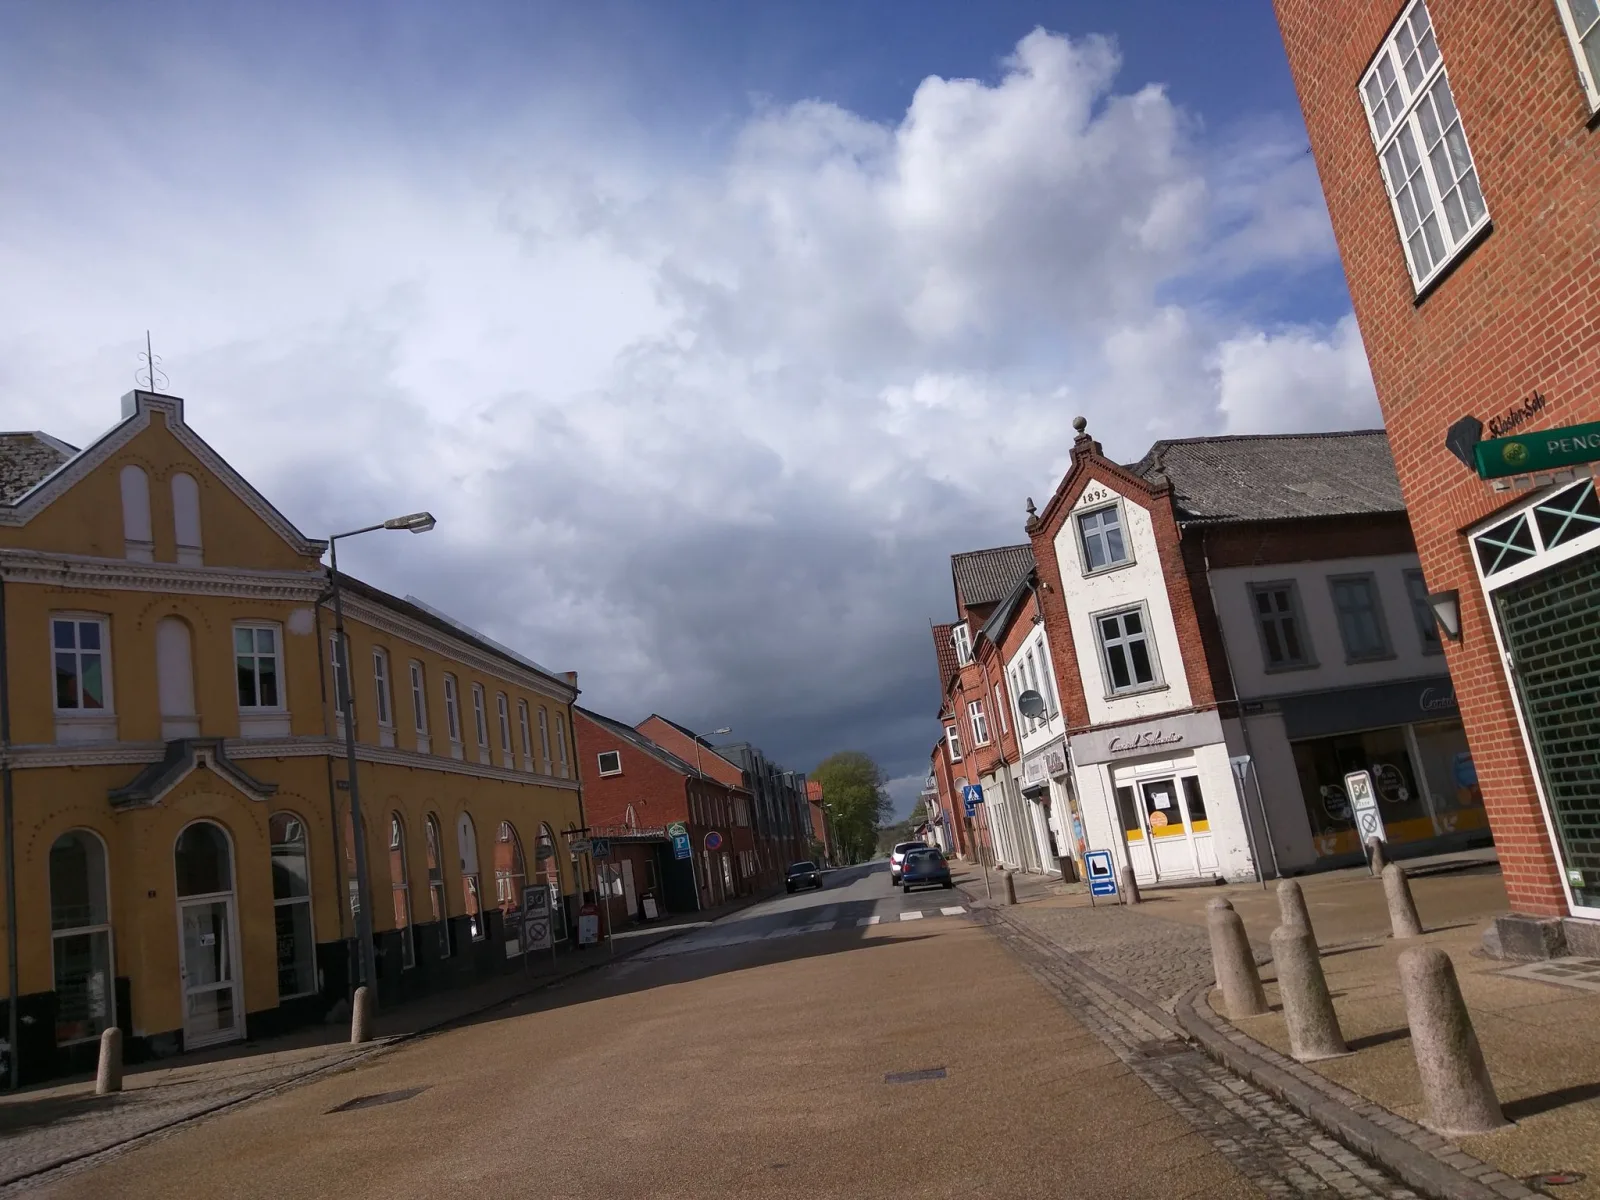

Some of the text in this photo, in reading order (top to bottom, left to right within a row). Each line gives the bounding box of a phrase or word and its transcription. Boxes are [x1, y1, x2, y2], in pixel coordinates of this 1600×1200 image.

[1083, 489, 1107, 504] 1895
[1353, 783, 1367, 796] 30
[527, 894, 544, 906] 30
